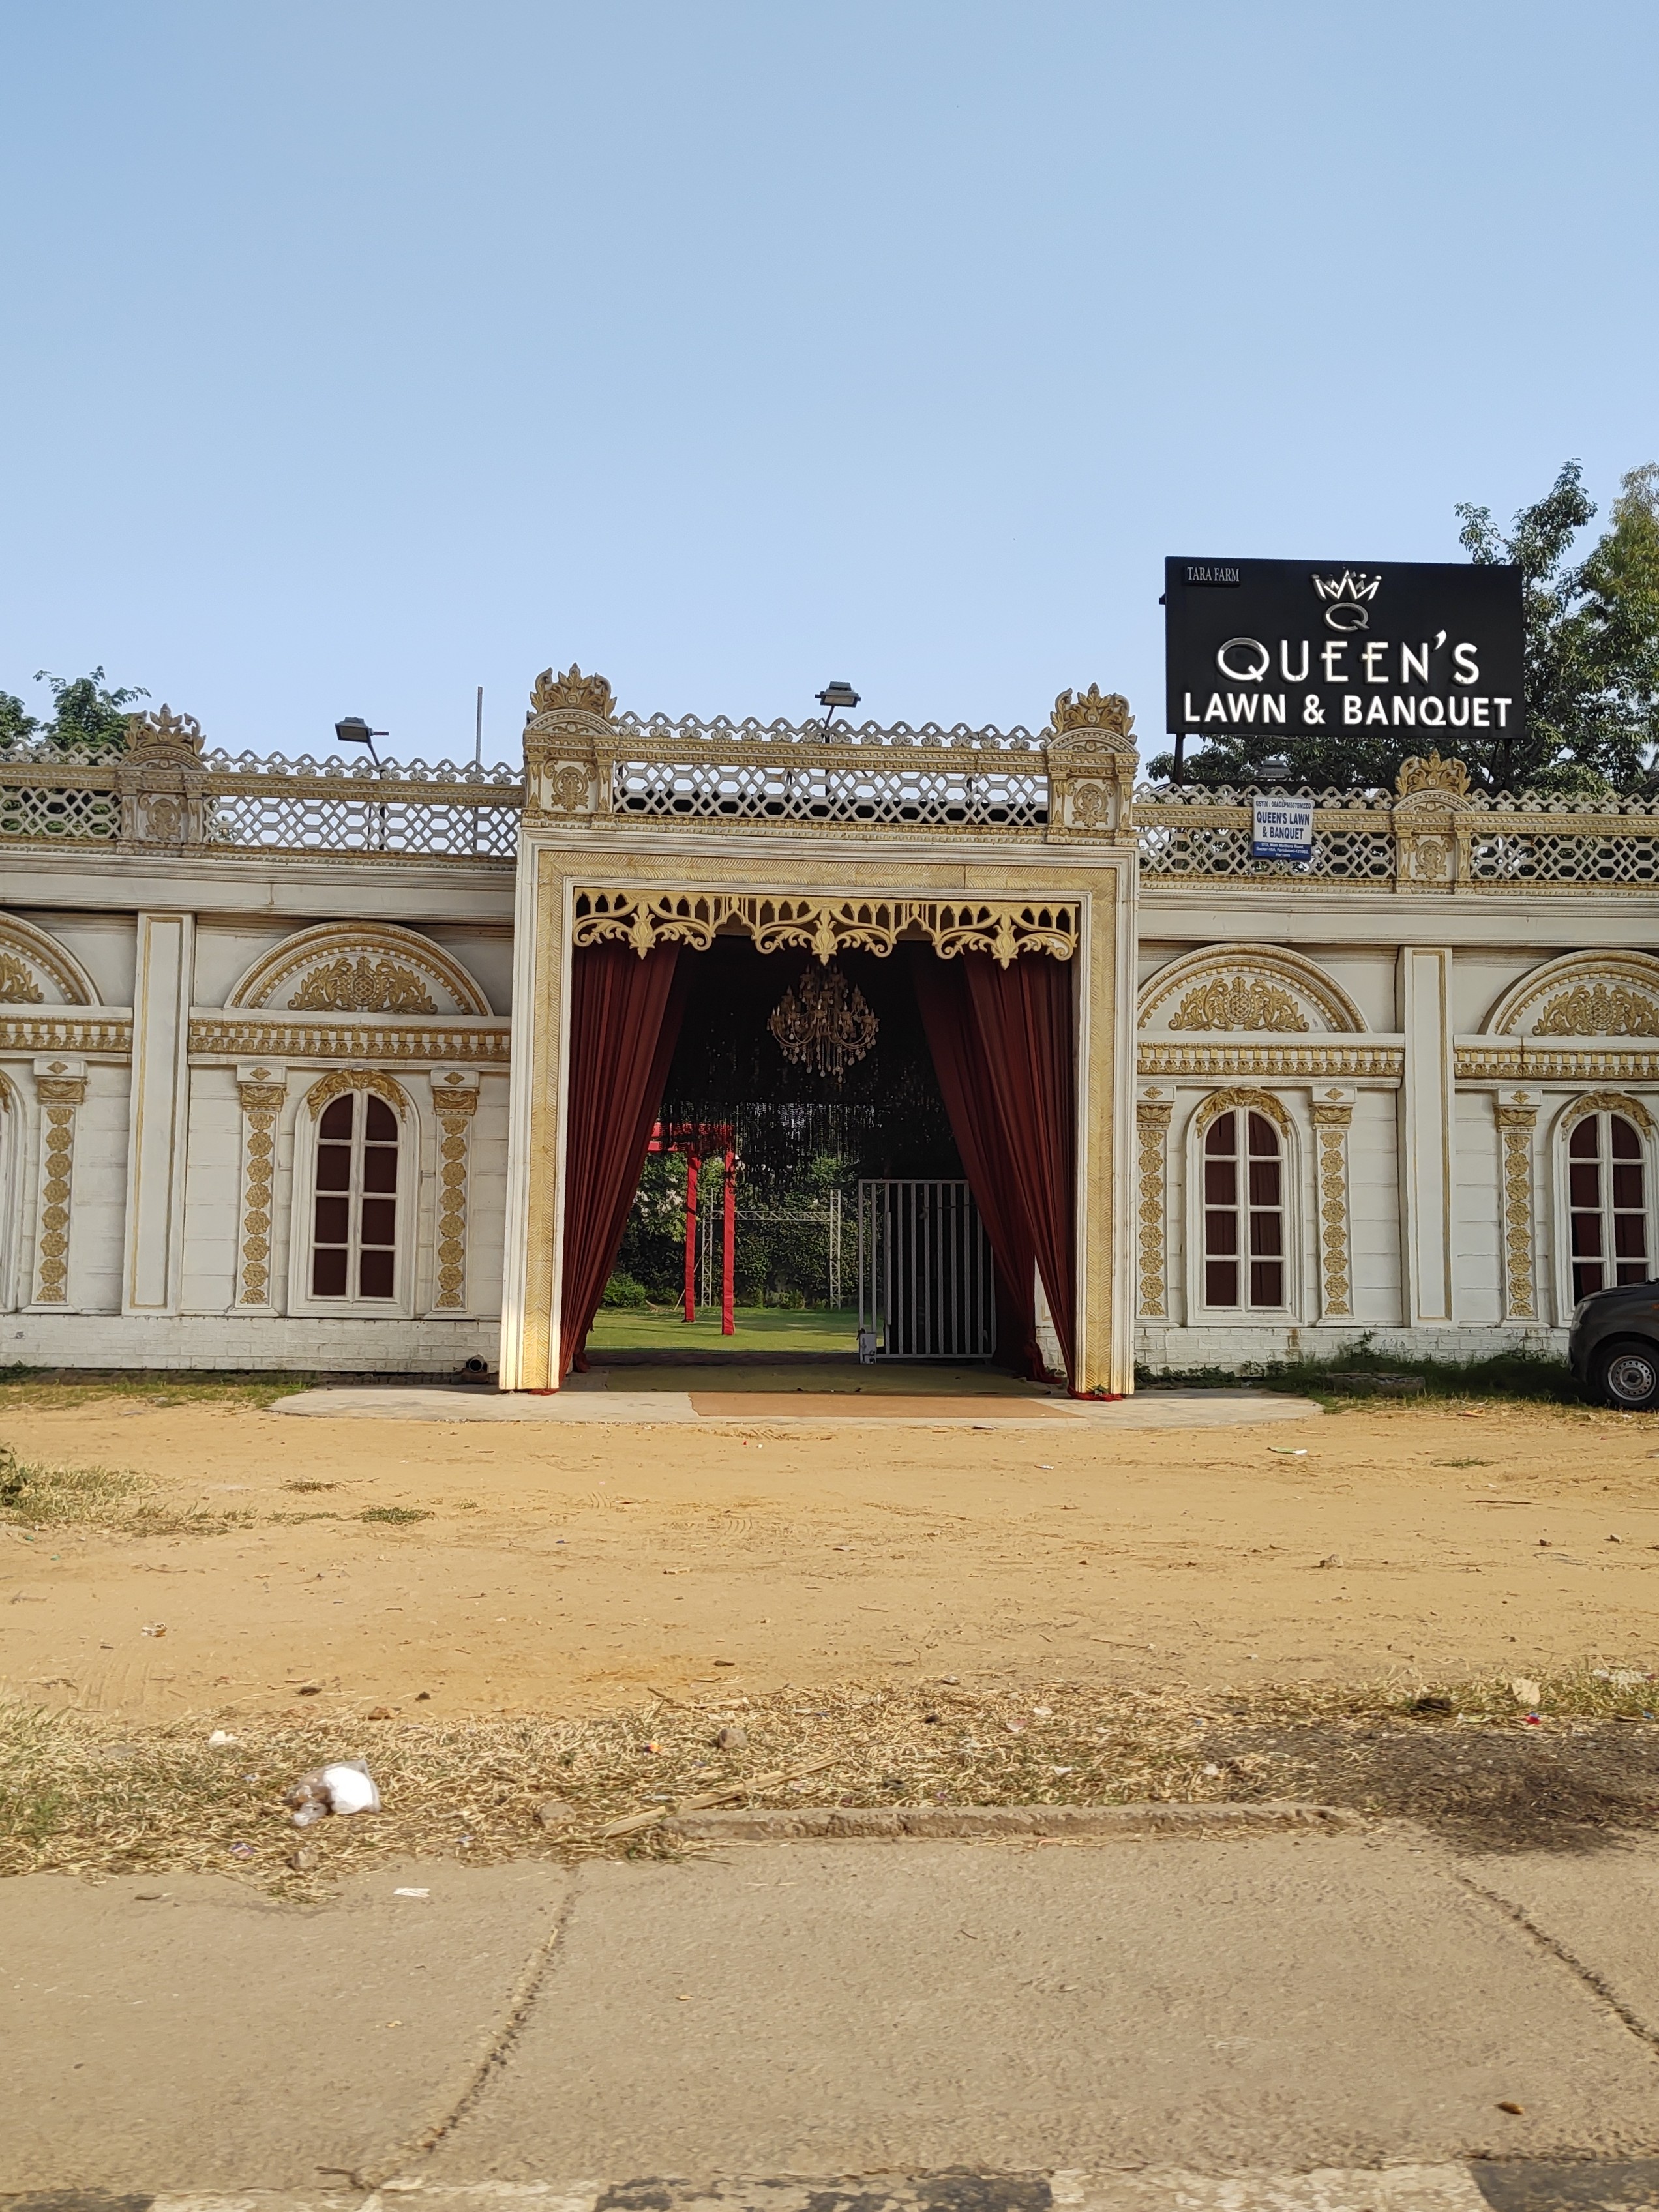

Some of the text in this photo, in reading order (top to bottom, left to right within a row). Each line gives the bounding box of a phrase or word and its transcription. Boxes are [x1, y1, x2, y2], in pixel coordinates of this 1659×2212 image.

[1187, 567, 1240, 582] TARA FARM
[1323, 602, 1370, 633] Q
[1216, 629, 1480, 686] QUEEN'S
[1184, 692, 1512, 728] LAWN & BANQUET
[1257, 811, 1310, 826] QUEEN'S LAWN
[1262, 826, 1304, 840] & BANQUET
